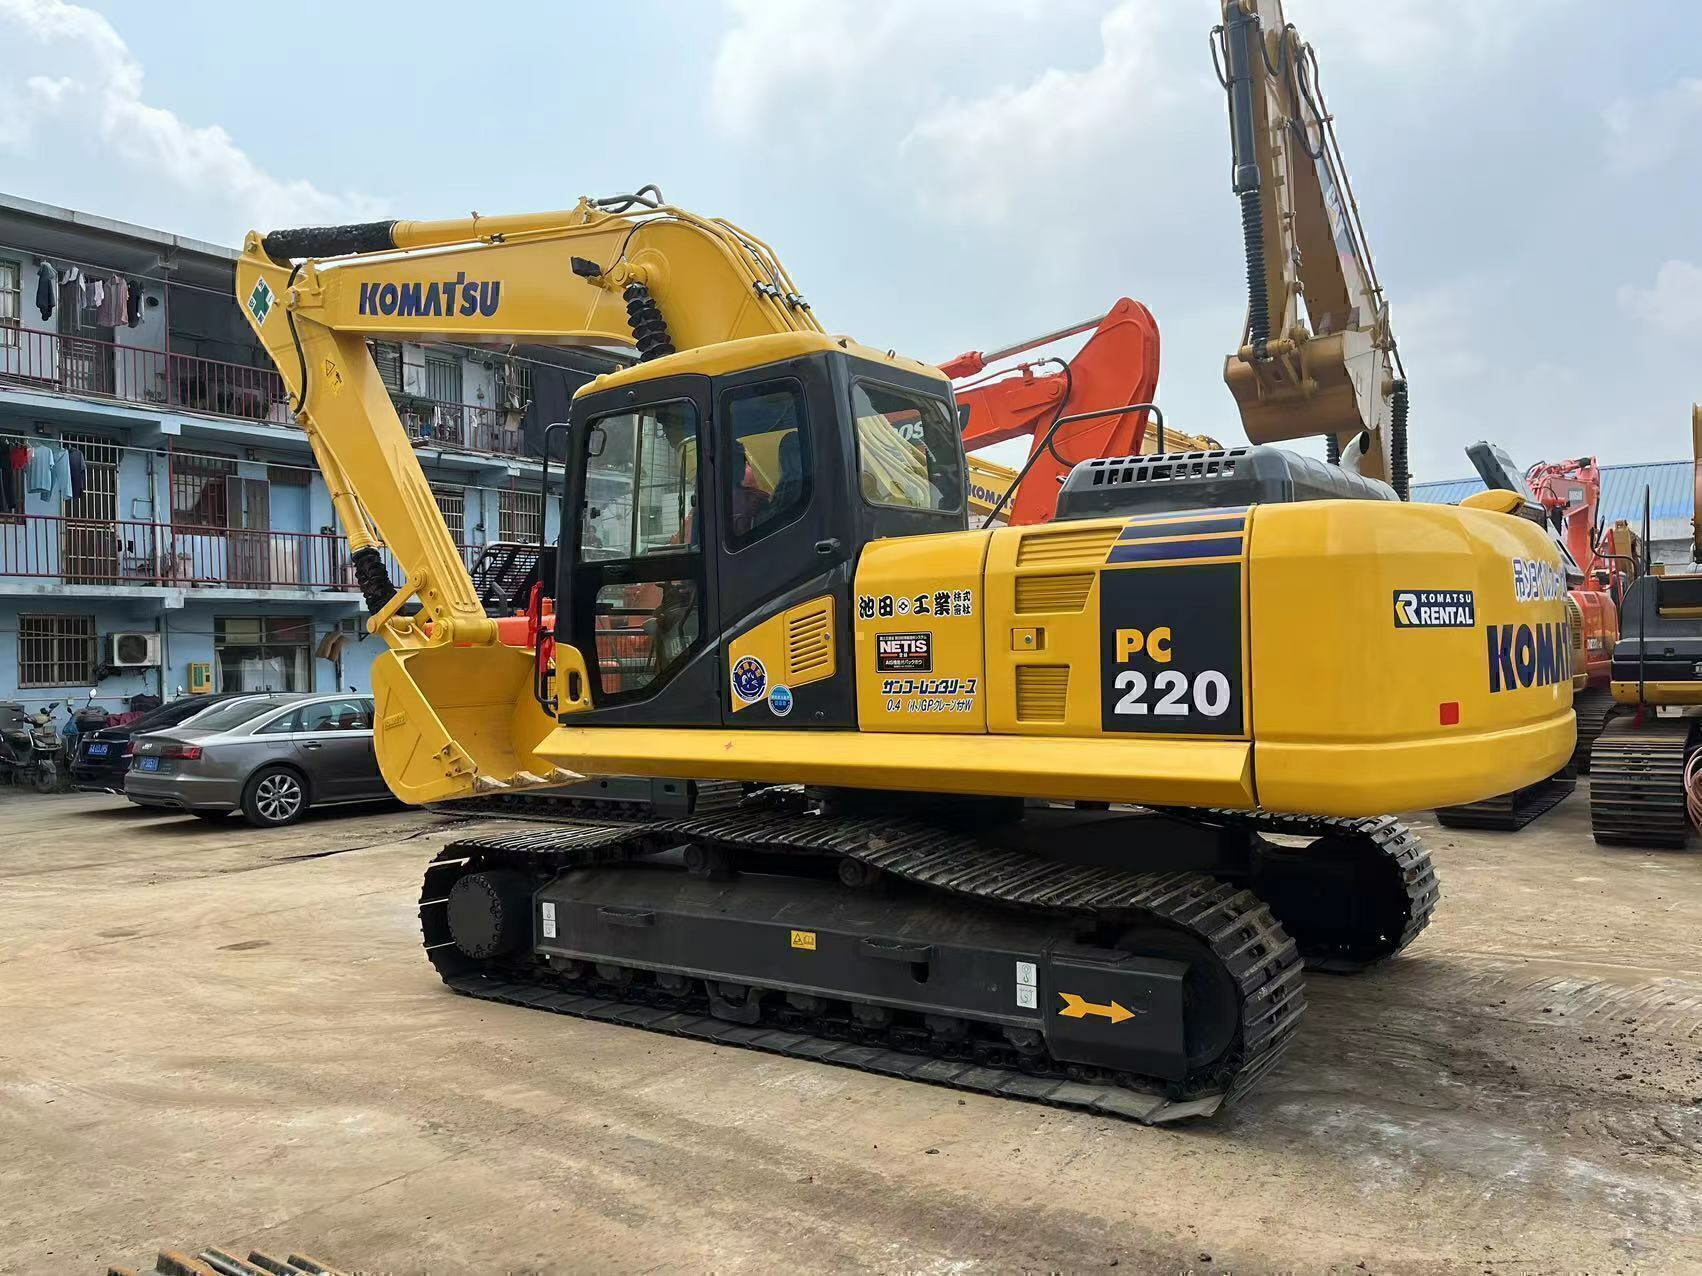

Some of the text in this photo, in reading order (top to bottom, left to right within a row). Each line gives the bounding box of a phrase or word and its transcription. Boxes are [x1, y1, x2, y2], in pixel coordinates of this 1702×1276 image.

[359, 271, 501, 317] KOMATSU
[1421, 593, 1472, 603] KOMATSU
[1421, 606, 1474, 625] RENTAL
[879, 639, 928, 653] NETIS
[1116, 626, 1172, 663] PC
[1113, 669, 1231, 717] 220
[886, 698, 902, 712] 0.4
